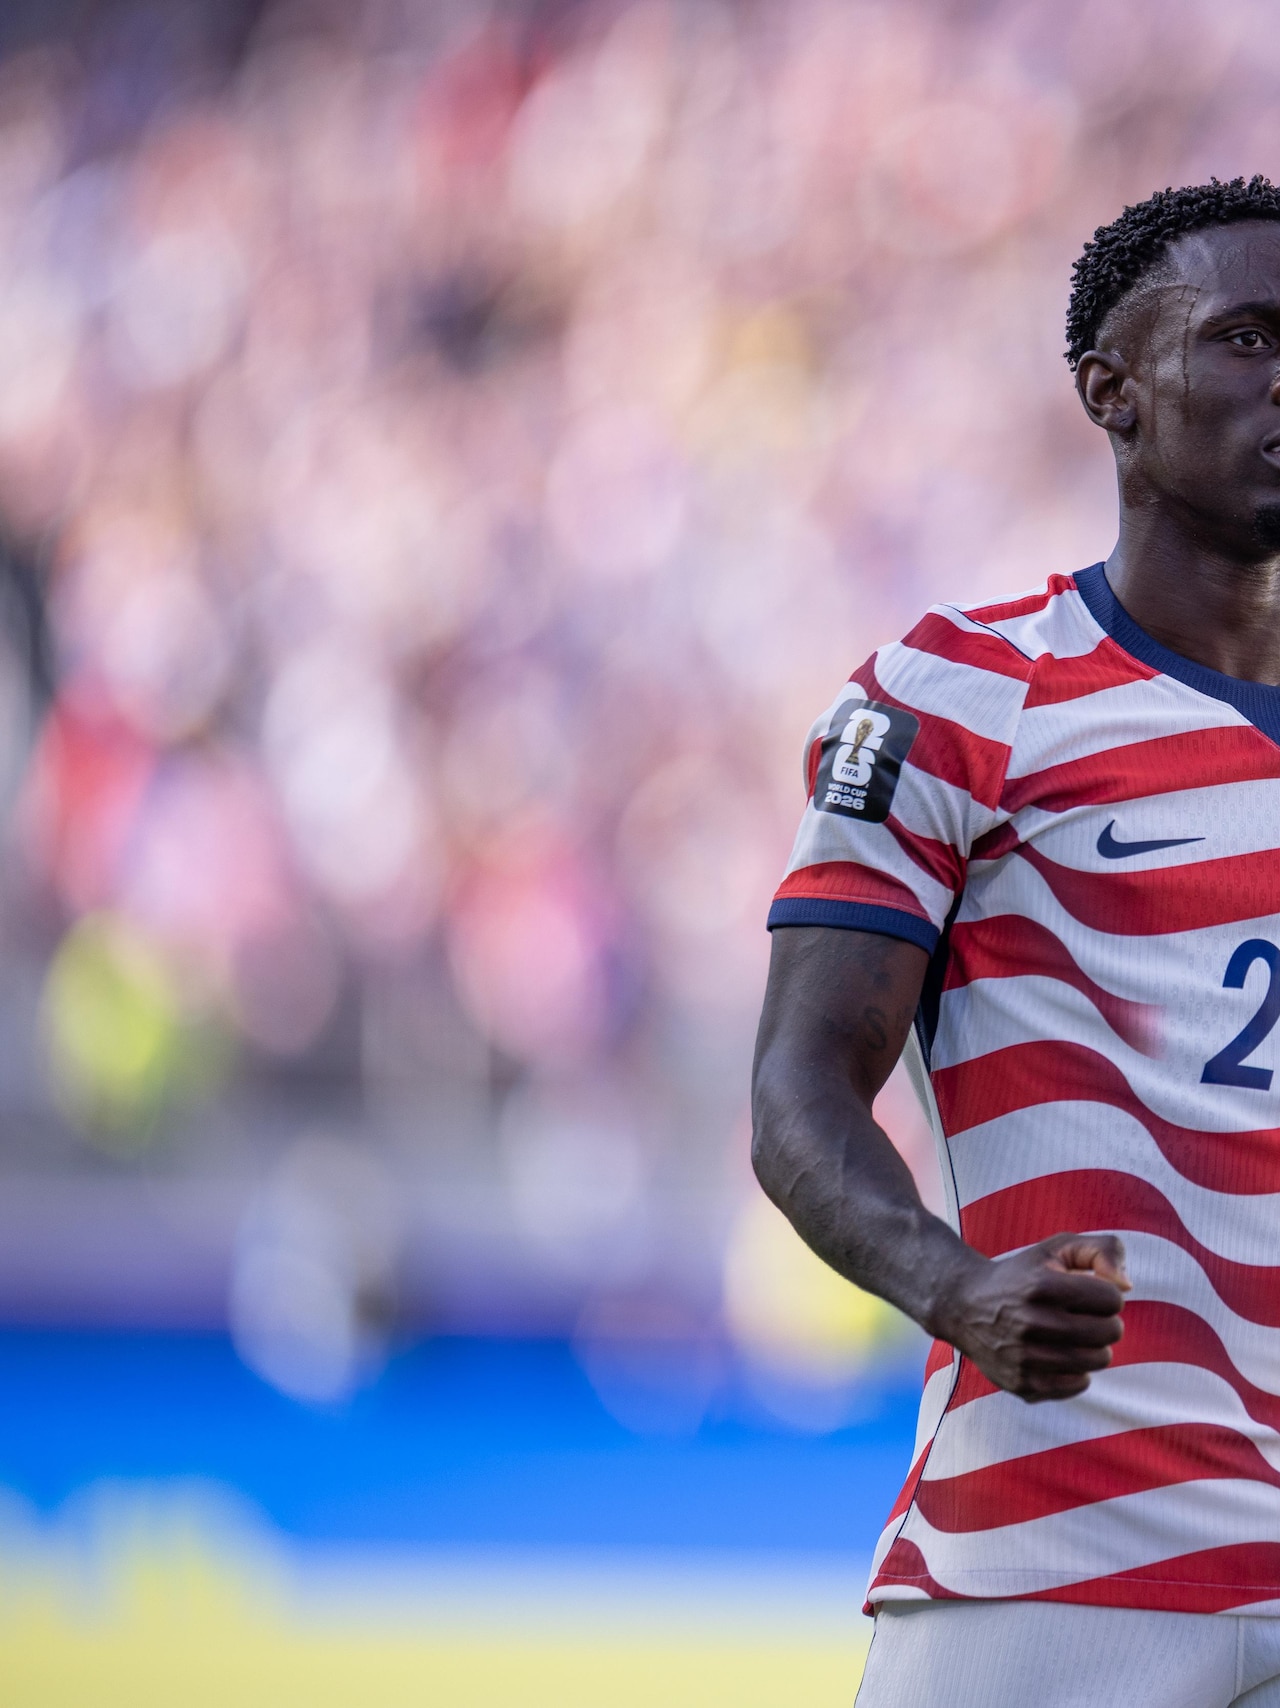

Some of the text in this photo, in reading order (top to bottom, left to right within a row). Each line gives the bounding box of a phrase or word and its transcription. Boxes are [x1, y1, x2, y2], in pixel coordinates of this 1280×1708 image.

[840, 766, 859, 778] FIFA
[827, 783, 867, 797] WORLD CUP
[824, 791, 865, 810] 2026
